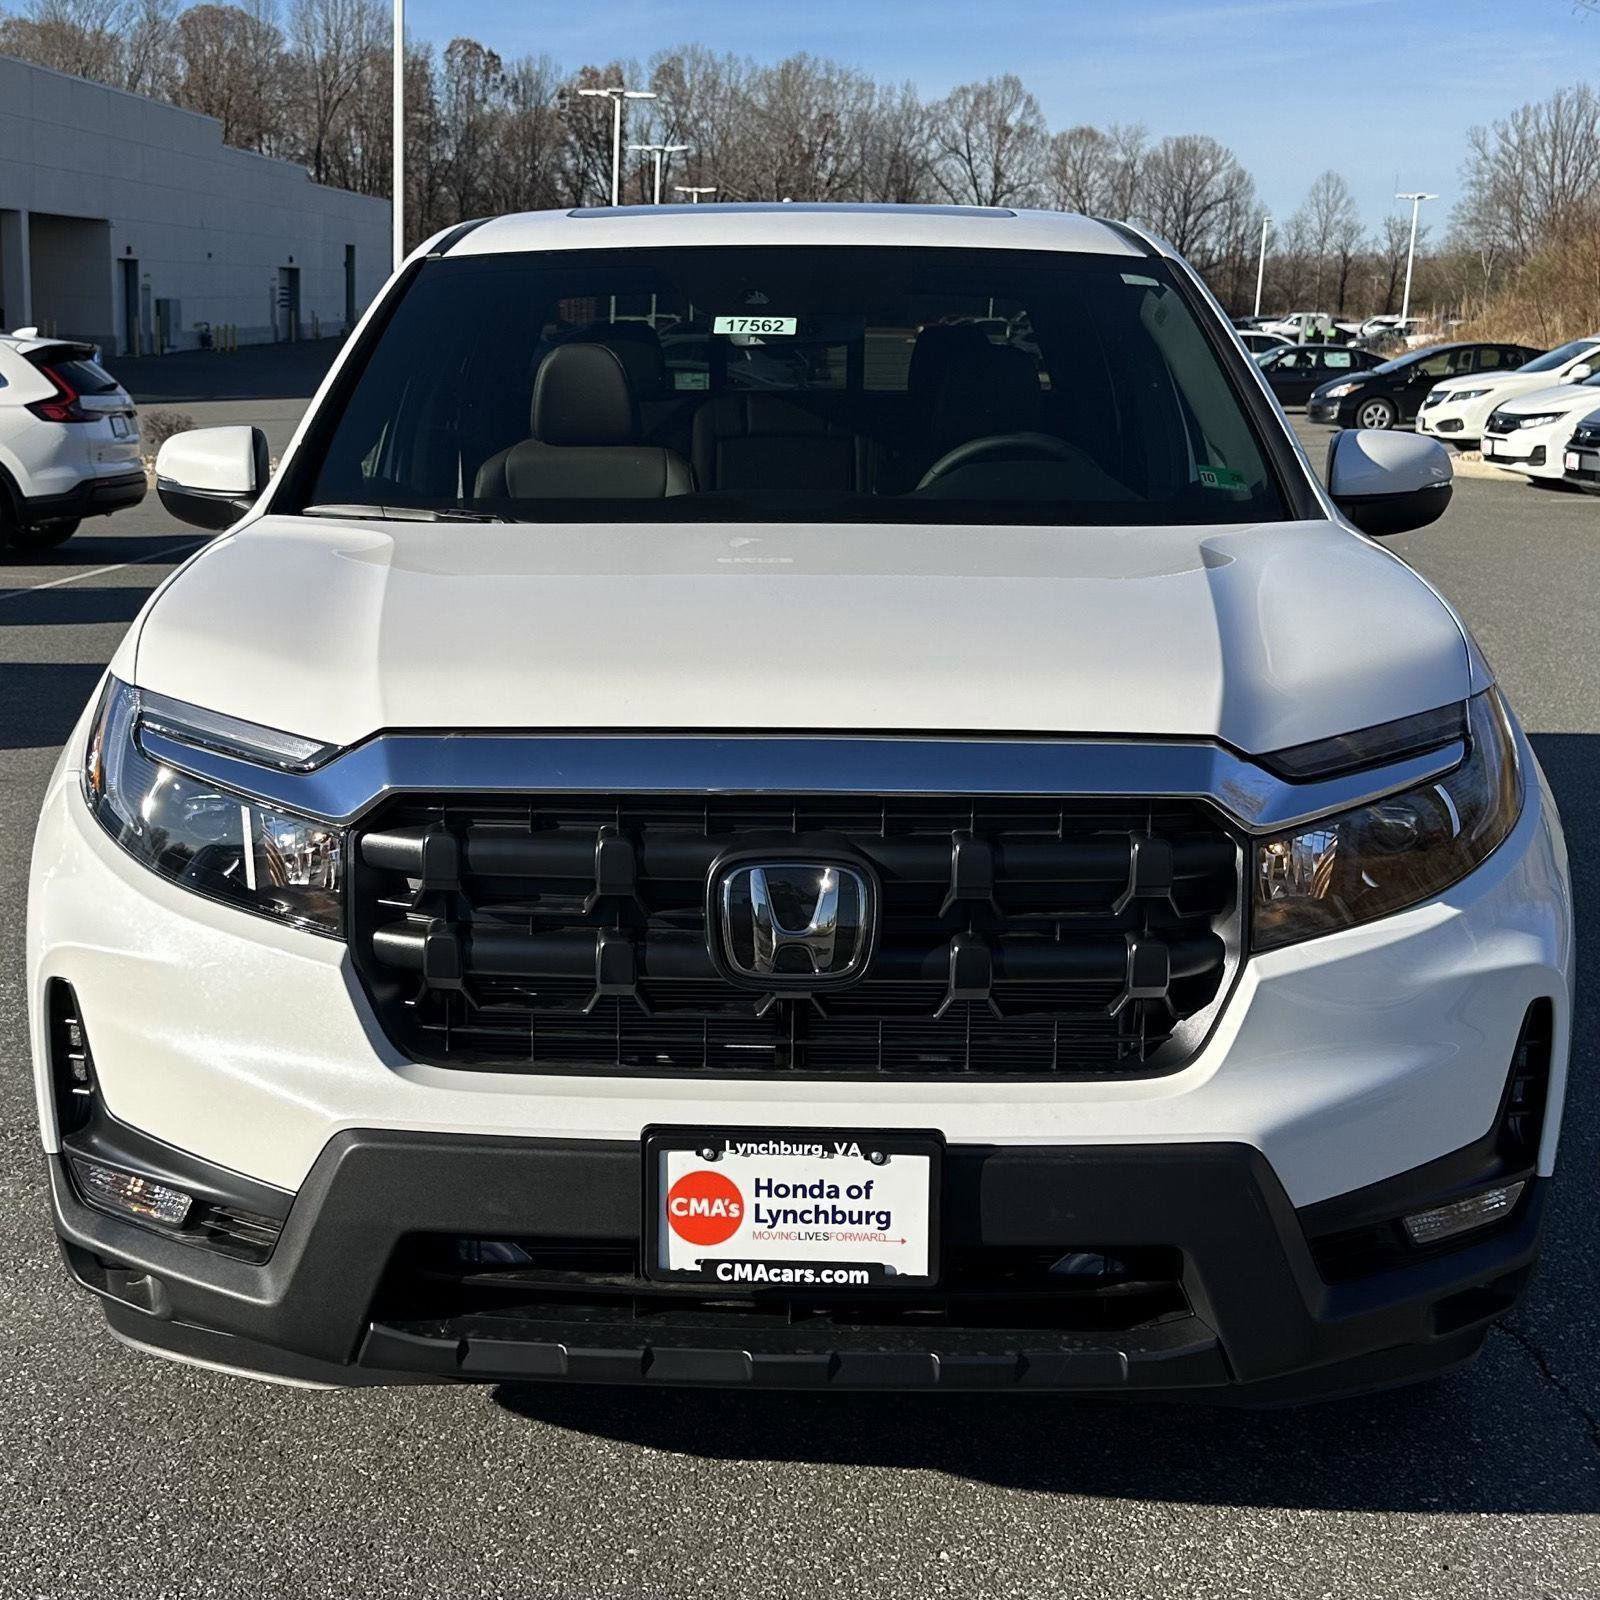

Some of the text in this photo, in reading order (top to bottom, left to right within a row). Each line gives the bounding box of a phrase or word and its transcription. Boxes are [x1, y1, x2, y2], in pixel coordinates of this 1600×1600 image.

[726, 319, 784, 332] 17562
[1201, 472, 1215, 482] 10
[725, 1140, 862, 1158] Lynchburg, VA
[754, 1178, 874, 1199] Honda of
[670, 1197, 740, 1218] CMA's
[754, 1203, 892, 1230] Lynchburg
[716, 1263, 869, 1284] CMAcars.com
